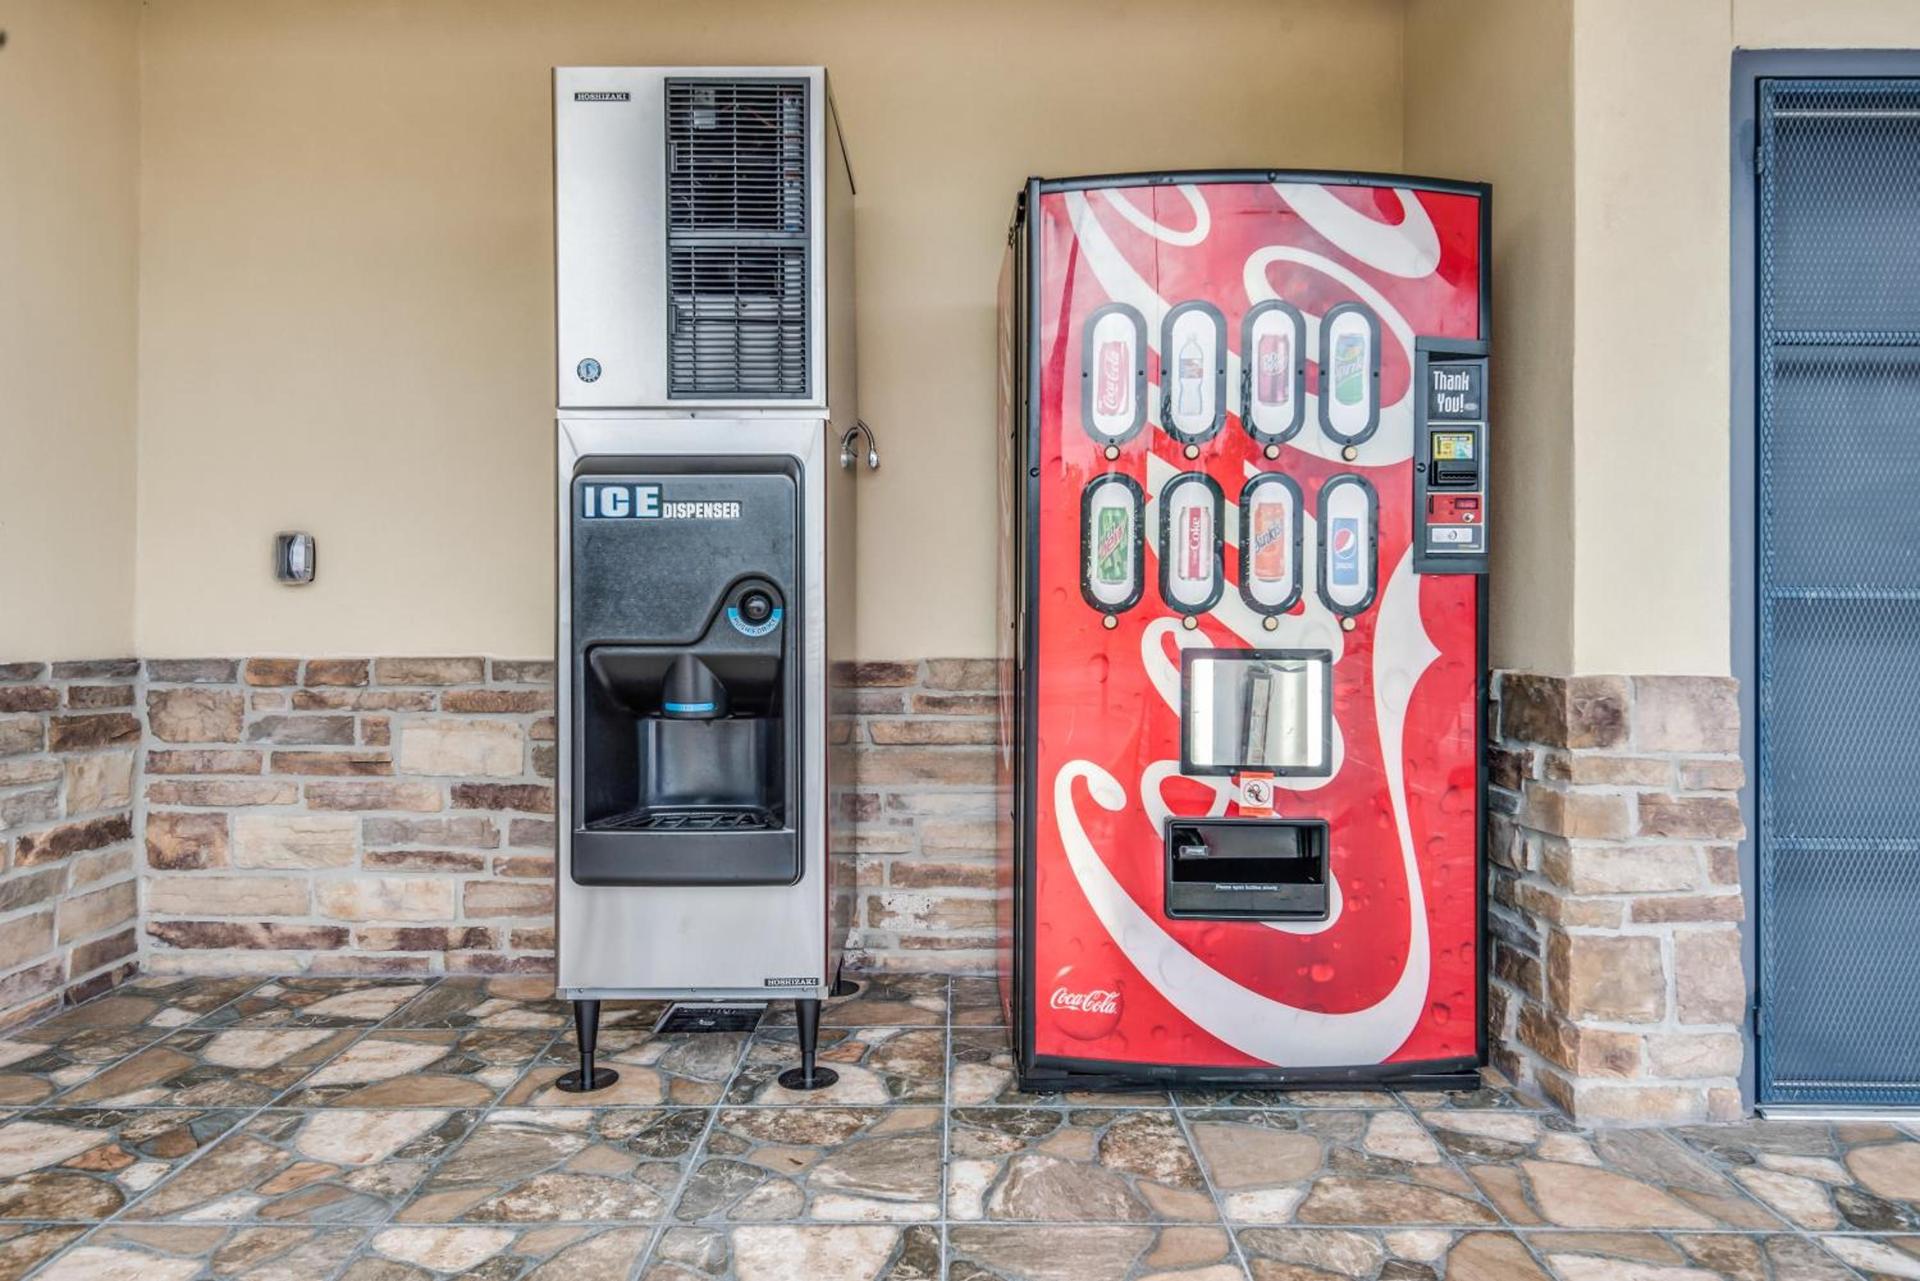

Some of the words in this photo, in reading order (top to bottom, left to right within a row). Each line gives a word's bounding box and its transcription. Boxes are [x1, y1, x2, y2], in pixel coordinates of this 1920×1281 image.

[577, 93, 627, 101] HOSHIZAKI
[1433, 370, 1470, 391] Thank
[1437, 392, 1464, 413] You!
[584, 486, 659, 517] ICE
[663, 502, 740, 518] DISPENSER
[1190, 516, 1201, 550] Coke
[767, 978, 816, 986] HOSHIZAKI
